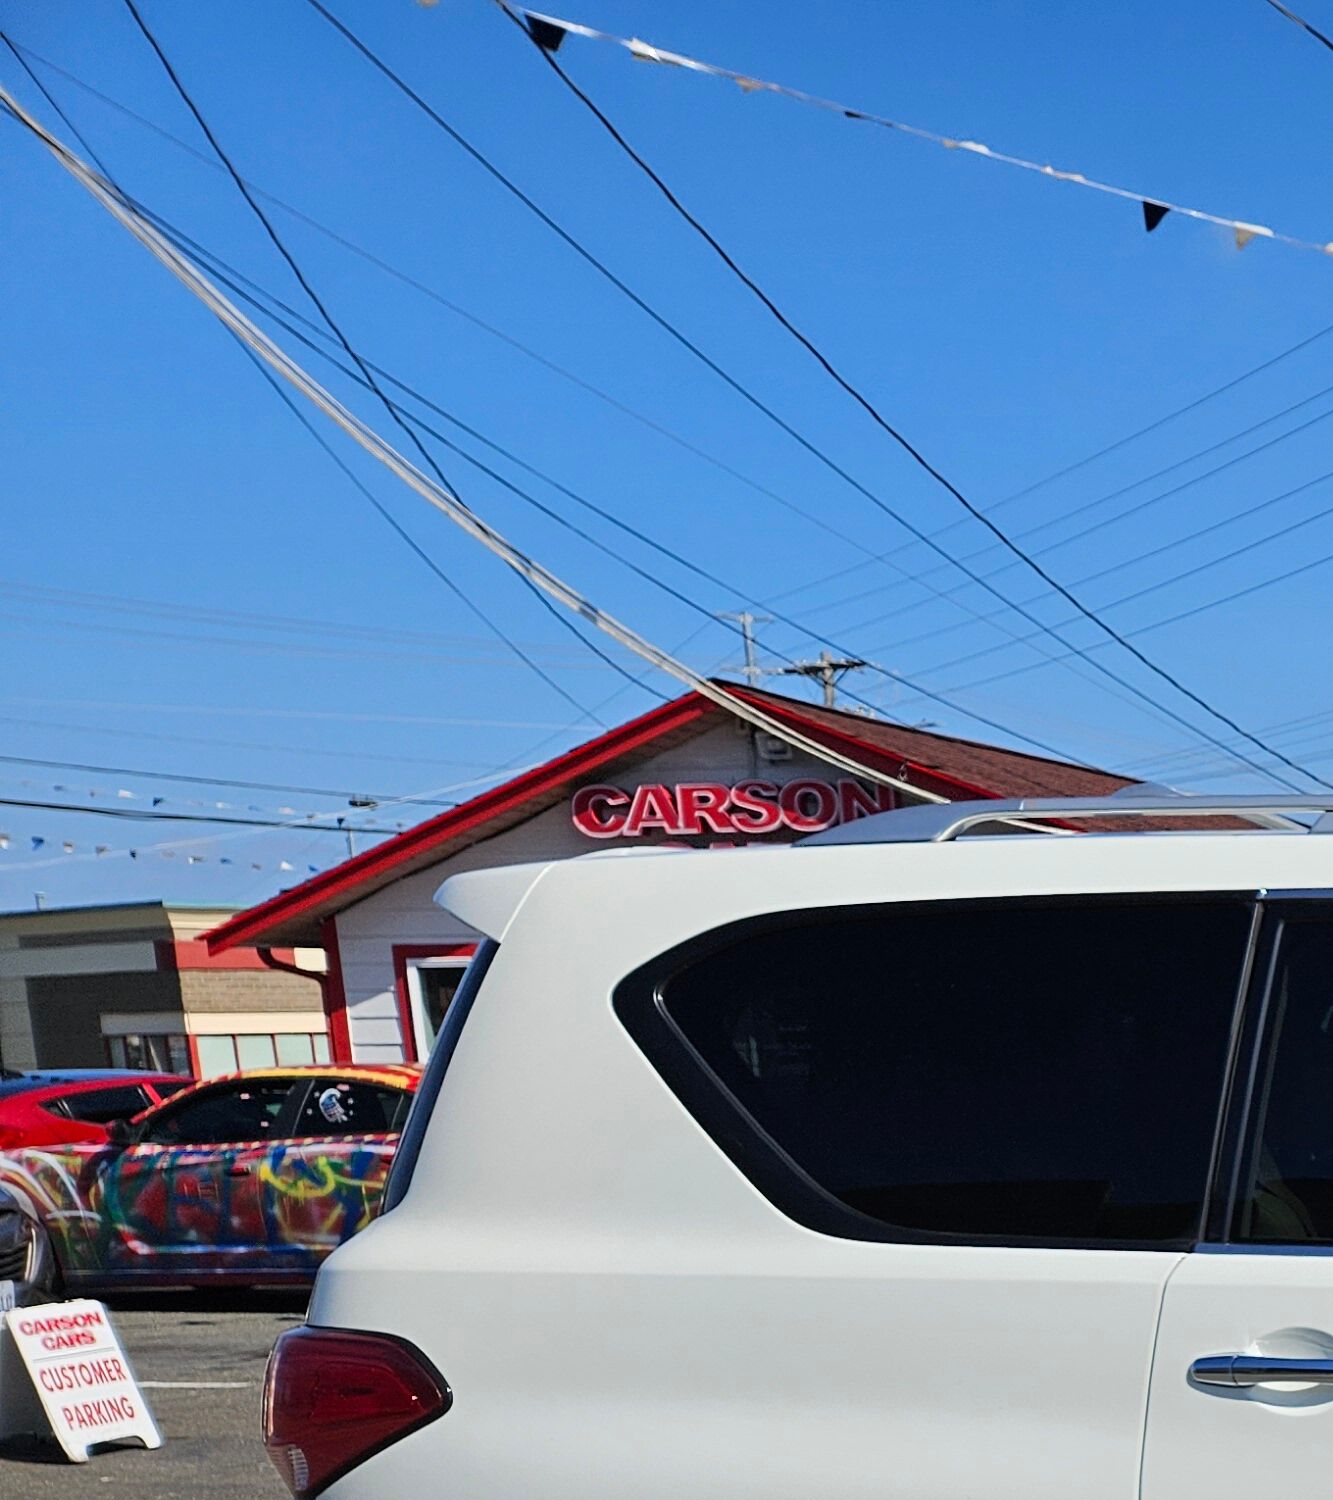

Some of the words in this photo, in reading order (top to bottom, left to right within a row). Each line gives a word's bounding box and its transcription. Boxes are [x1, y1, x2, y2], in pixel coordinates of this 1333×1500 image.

[572, 778, 899, 838] CARSON
[20, 1312, 102, 1335] CARSON
[42, 1331, 96, 1350] CARS
[39, 1359, 127, 1392] CUSTOMER
[62, 1397, 135, 1430] PARKING
